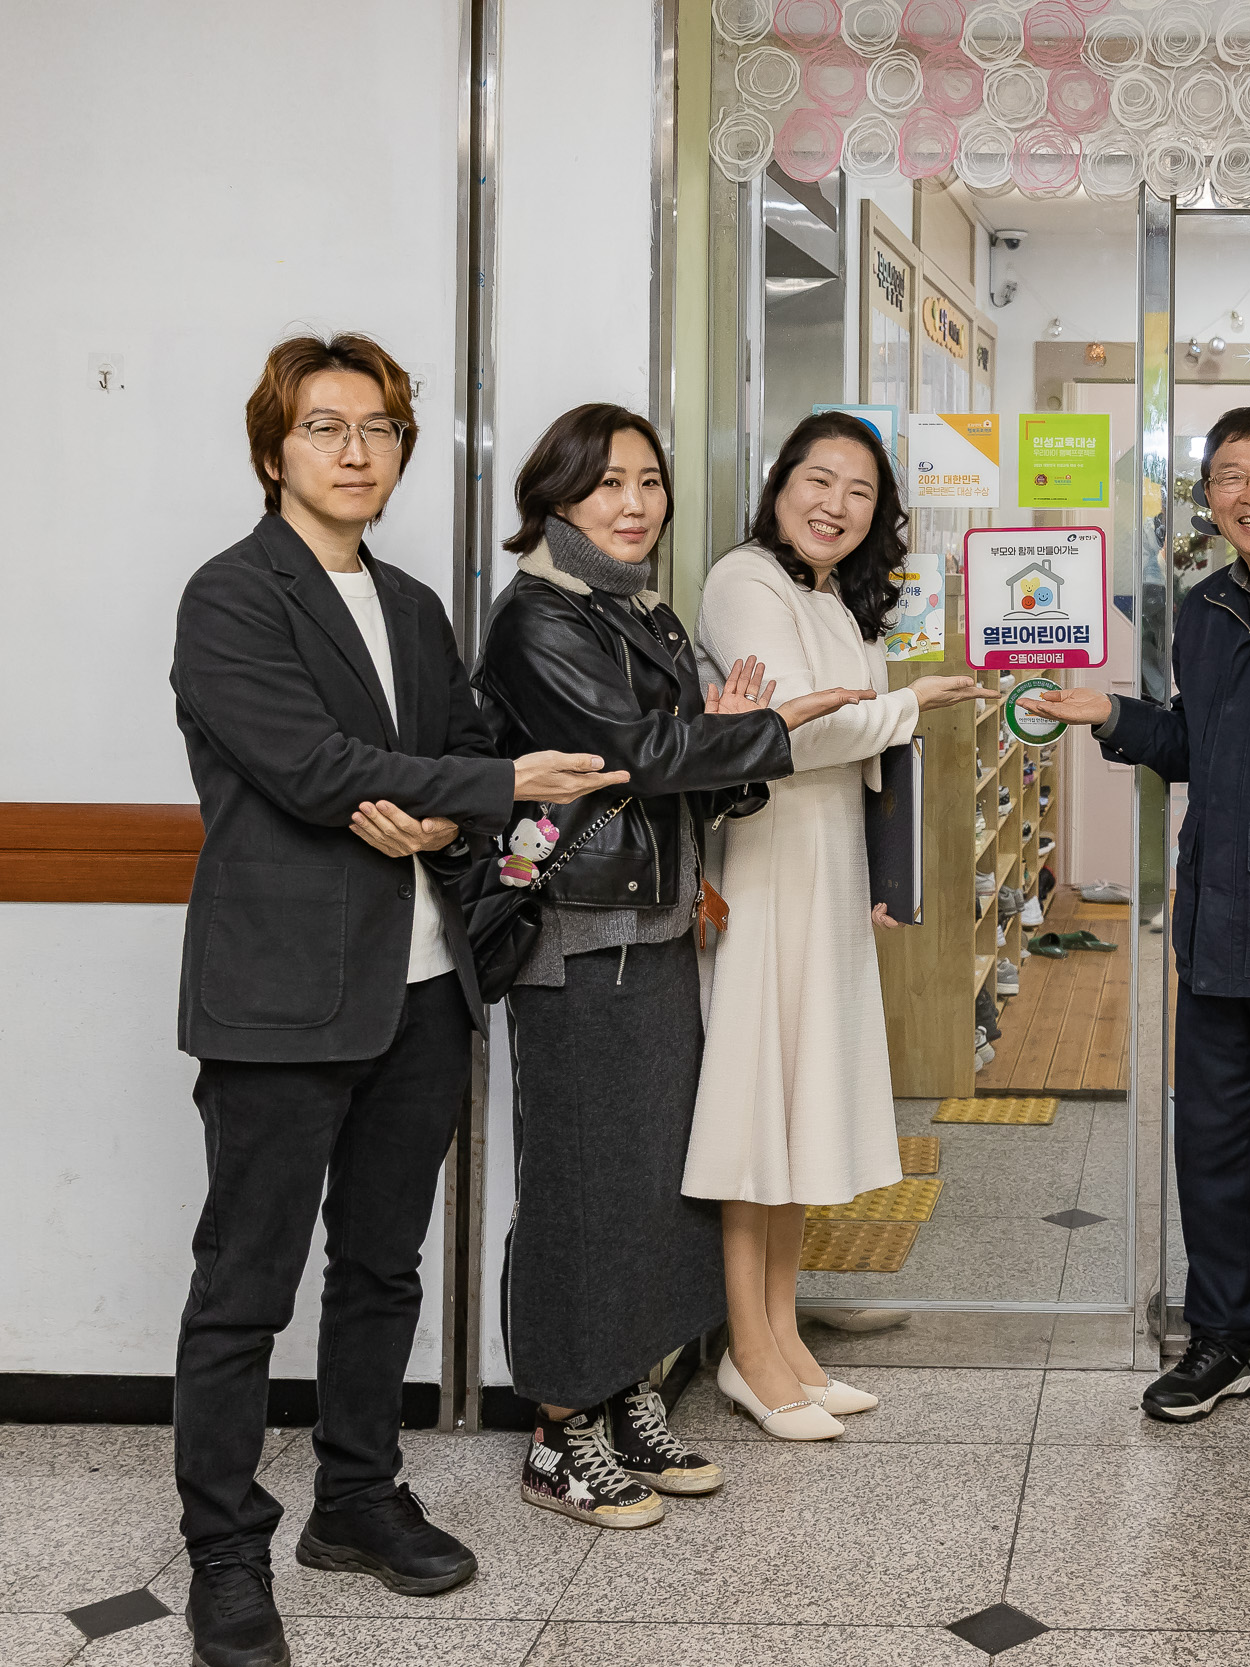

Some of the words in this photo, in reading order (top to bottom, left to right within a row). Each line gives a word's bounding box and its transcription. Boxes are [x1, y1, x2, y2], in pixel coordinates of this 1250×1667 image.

[1033, 437, 1096, 448] 인성교육대상
[918, 474, 940, 485] 2021
[943, 474, 980, 485] 대한민국
[918, 486, 955, 496] 교육브랜드
[957, 486, 972, 497] 대상
[974, 486, 989, 497] 수상
[991, 547, 1016, 556] 부모와
[1018, 546, 1035, 556] 함께
[1036, 545, 1079, 556] 만들어가는
[906, 586, 922, 596] 이용
[983, 625, 1090, 645] 열린어린이집
[1009, 653, 1064, 664] 으뜸어린이집
